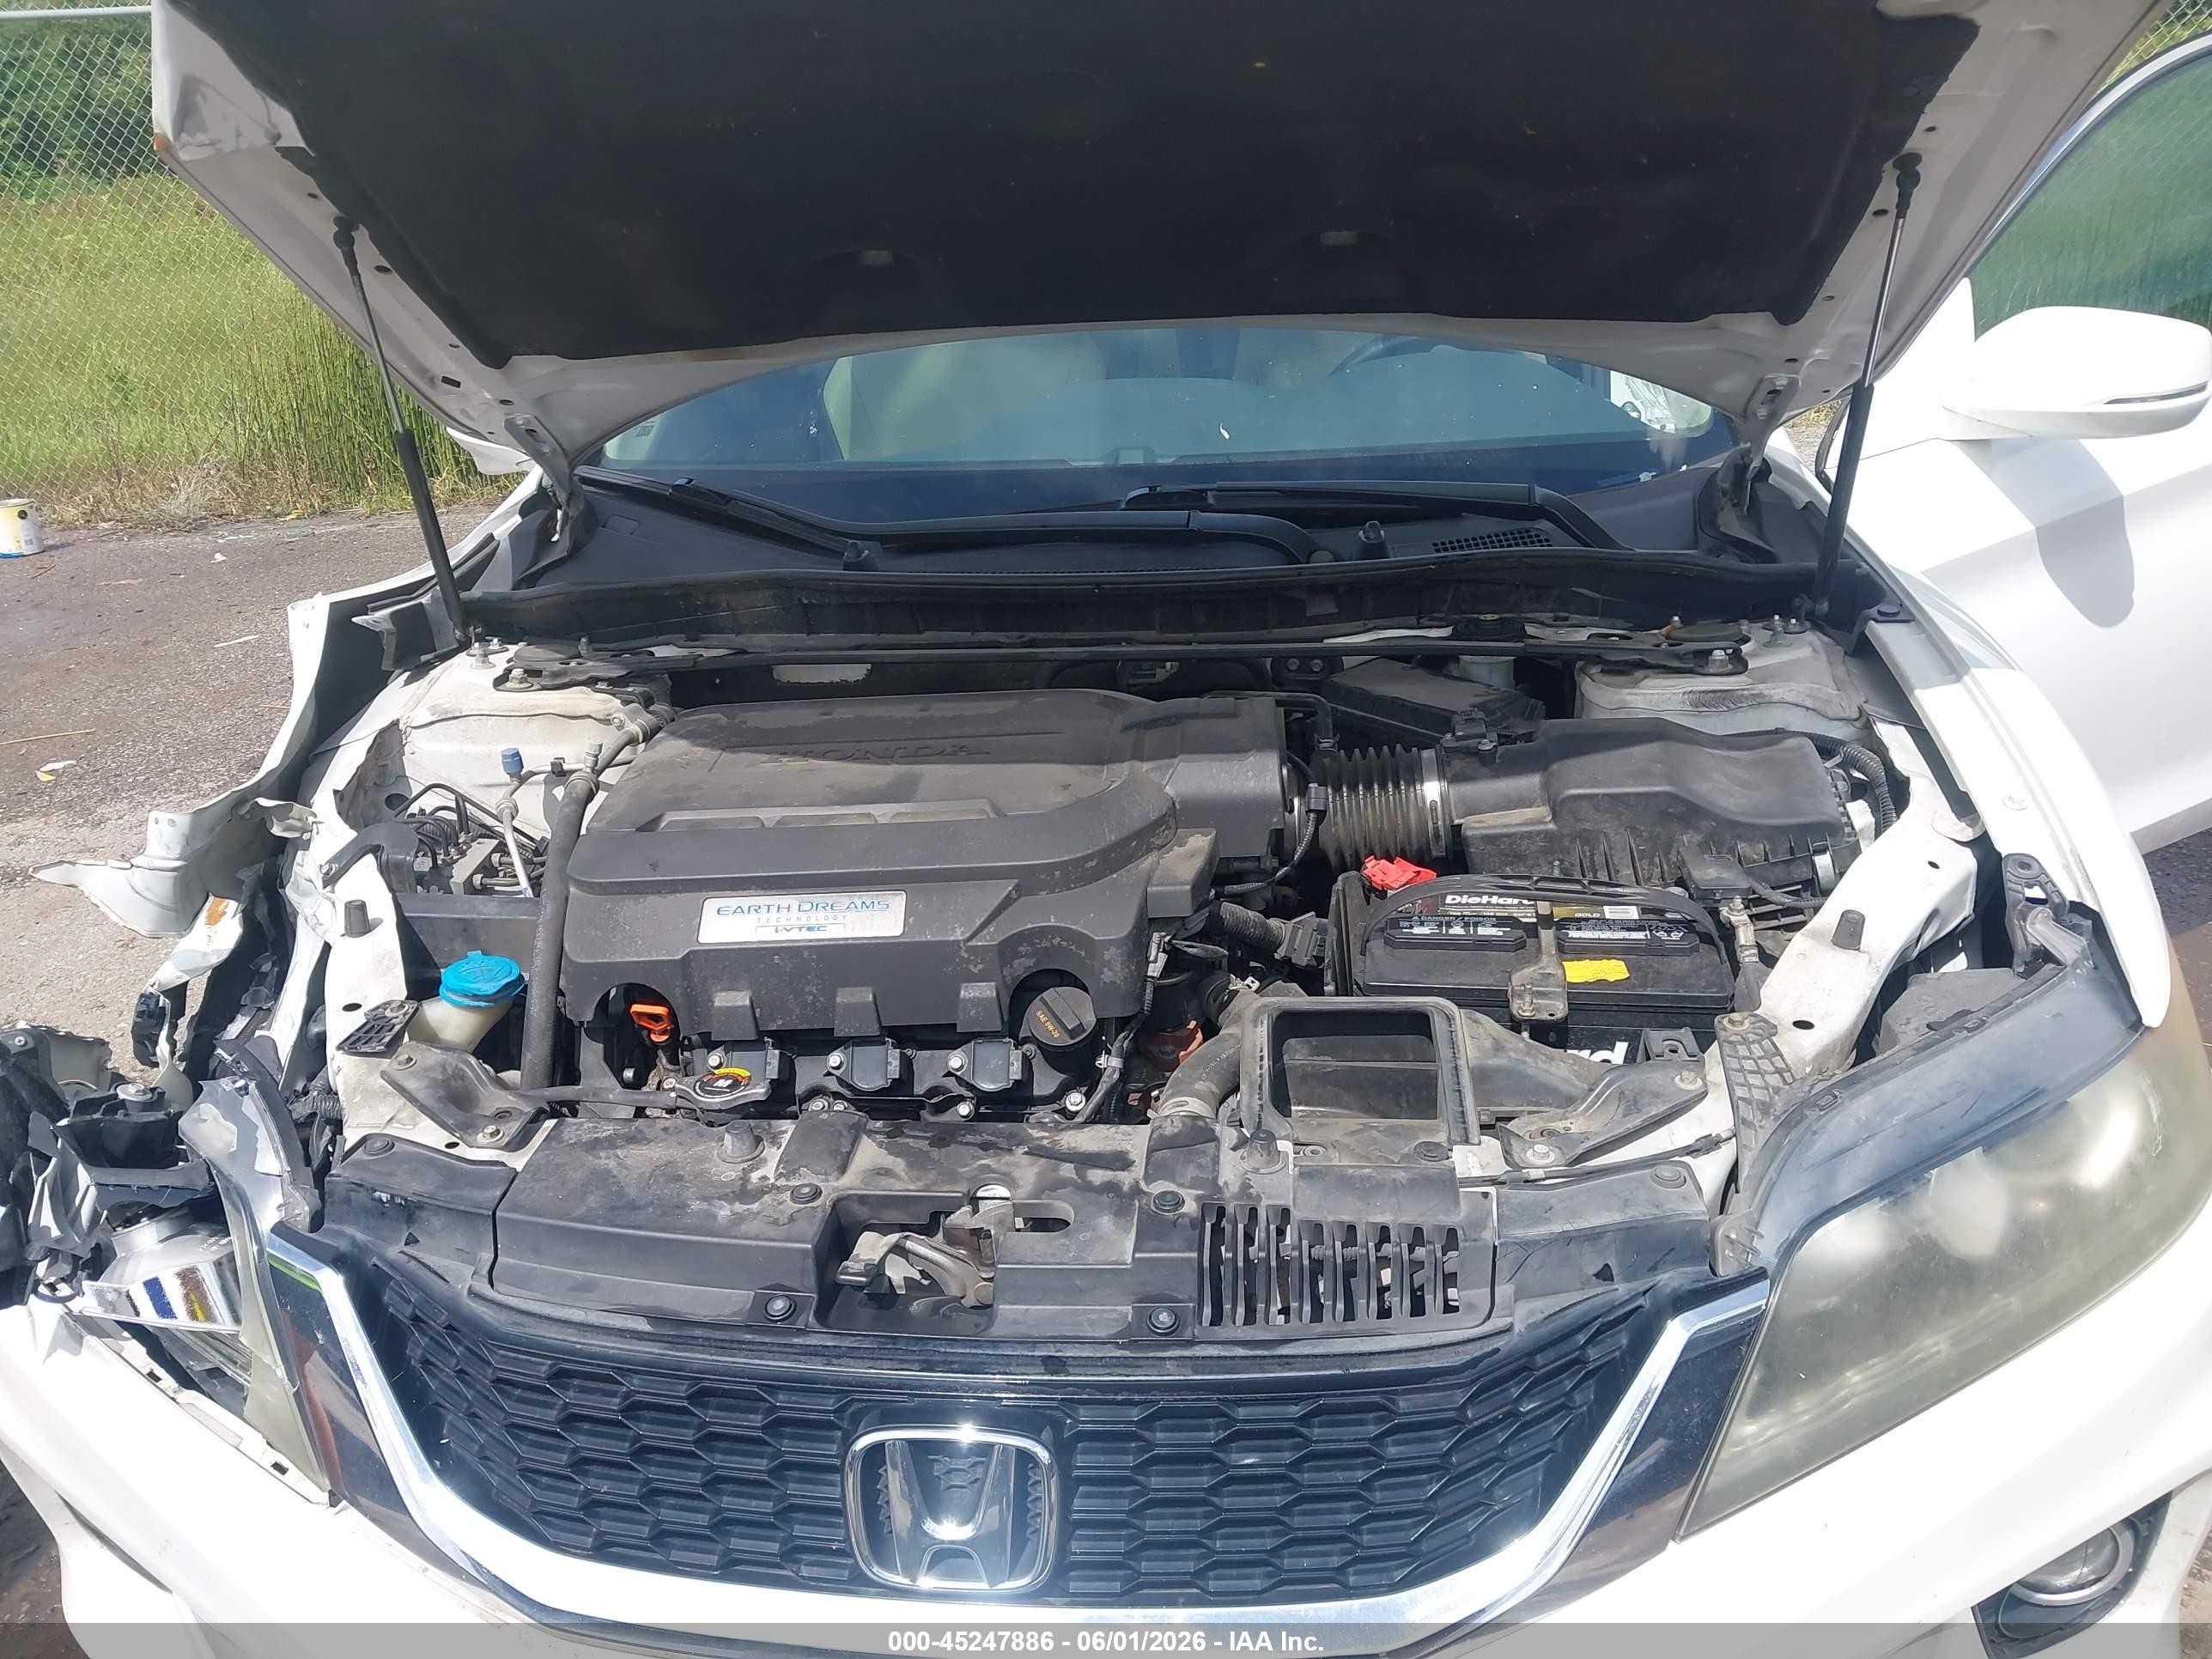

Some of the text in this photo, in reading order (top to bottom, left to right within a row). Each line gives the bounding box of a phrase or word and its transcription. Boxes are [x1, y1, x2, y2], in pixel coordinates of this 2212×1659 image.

[716, 900, 890, 916] EARTH DREAMS
[757, 915, 847, 924] TECHNOLOGY
[1036, 1010, 1060, 1038] SAE 0W-20
